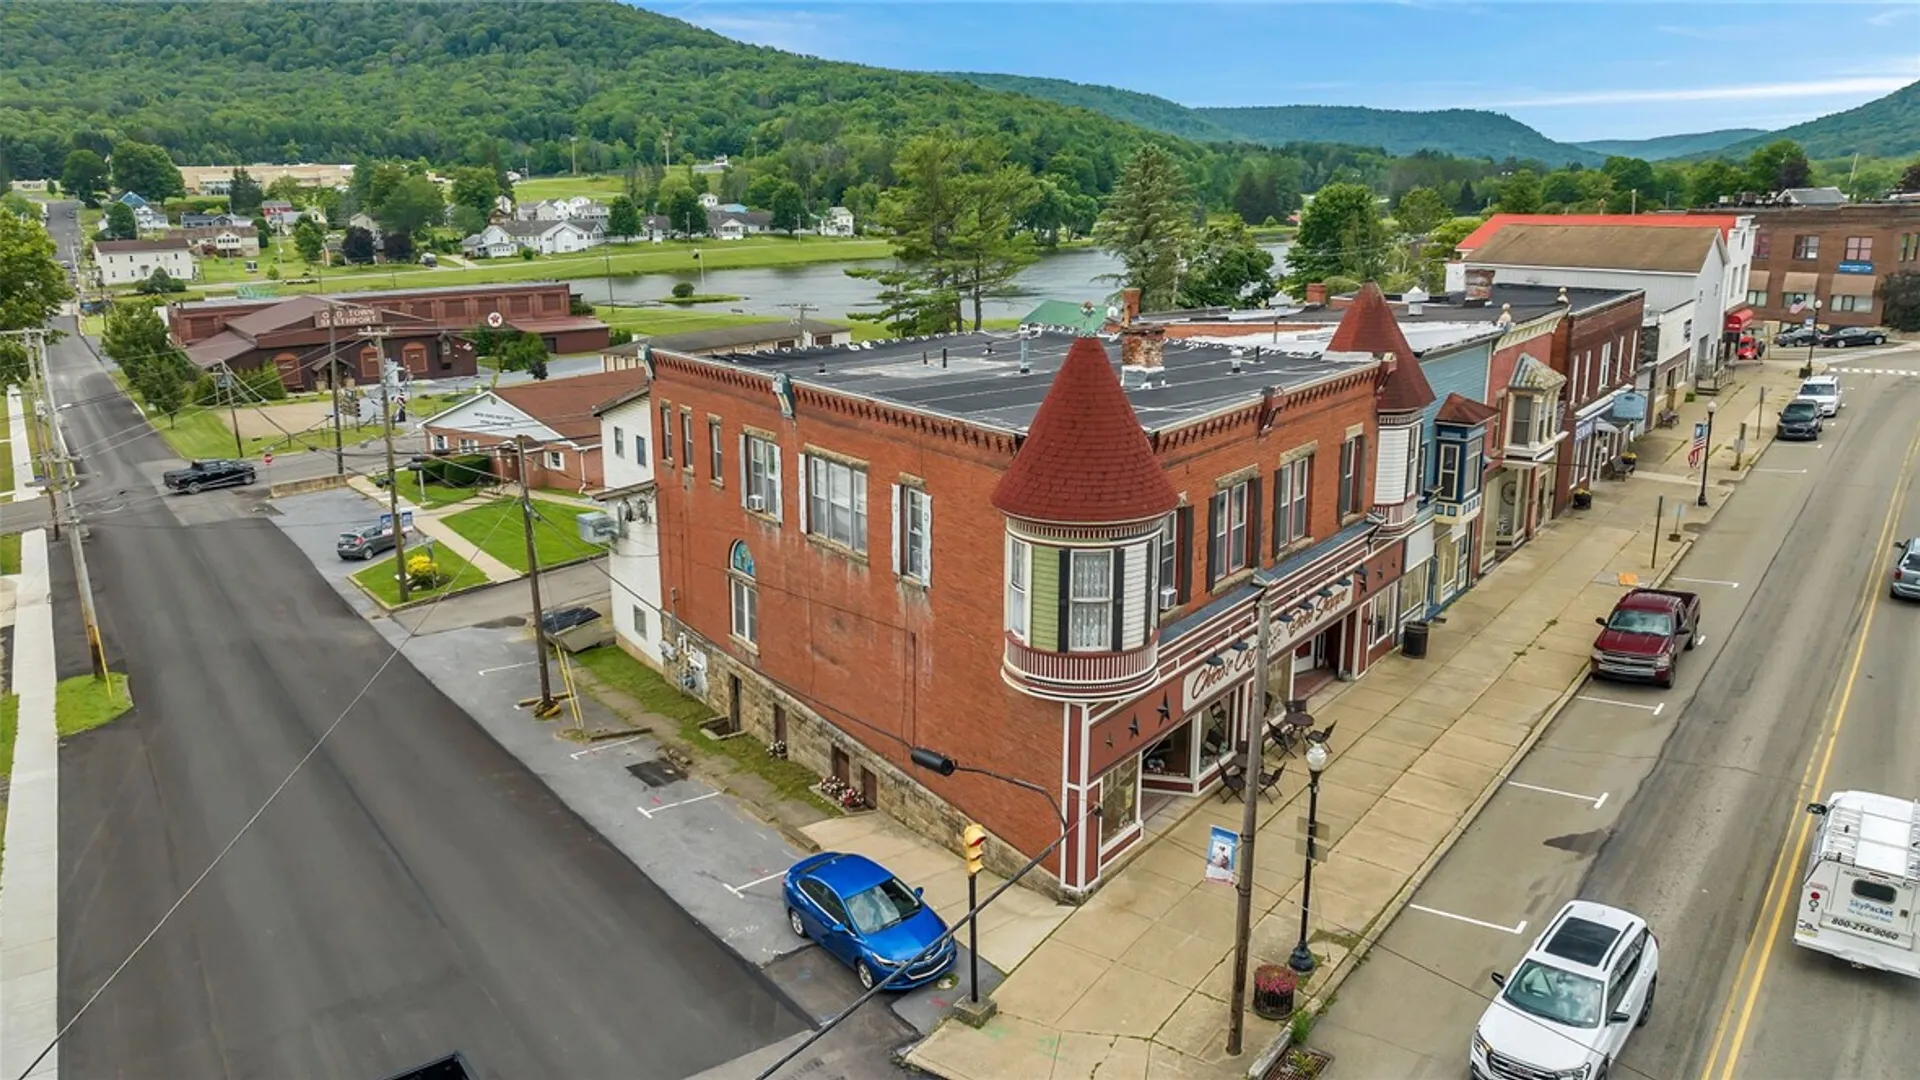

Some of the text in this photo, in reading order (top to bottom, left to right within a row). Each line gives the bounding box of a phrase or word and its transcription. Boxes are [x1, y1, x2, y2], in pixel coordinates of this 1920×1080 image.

[321, 308, 375, 319] OD TOWN
[1849, 899, 1894, 918] SkyPacket
